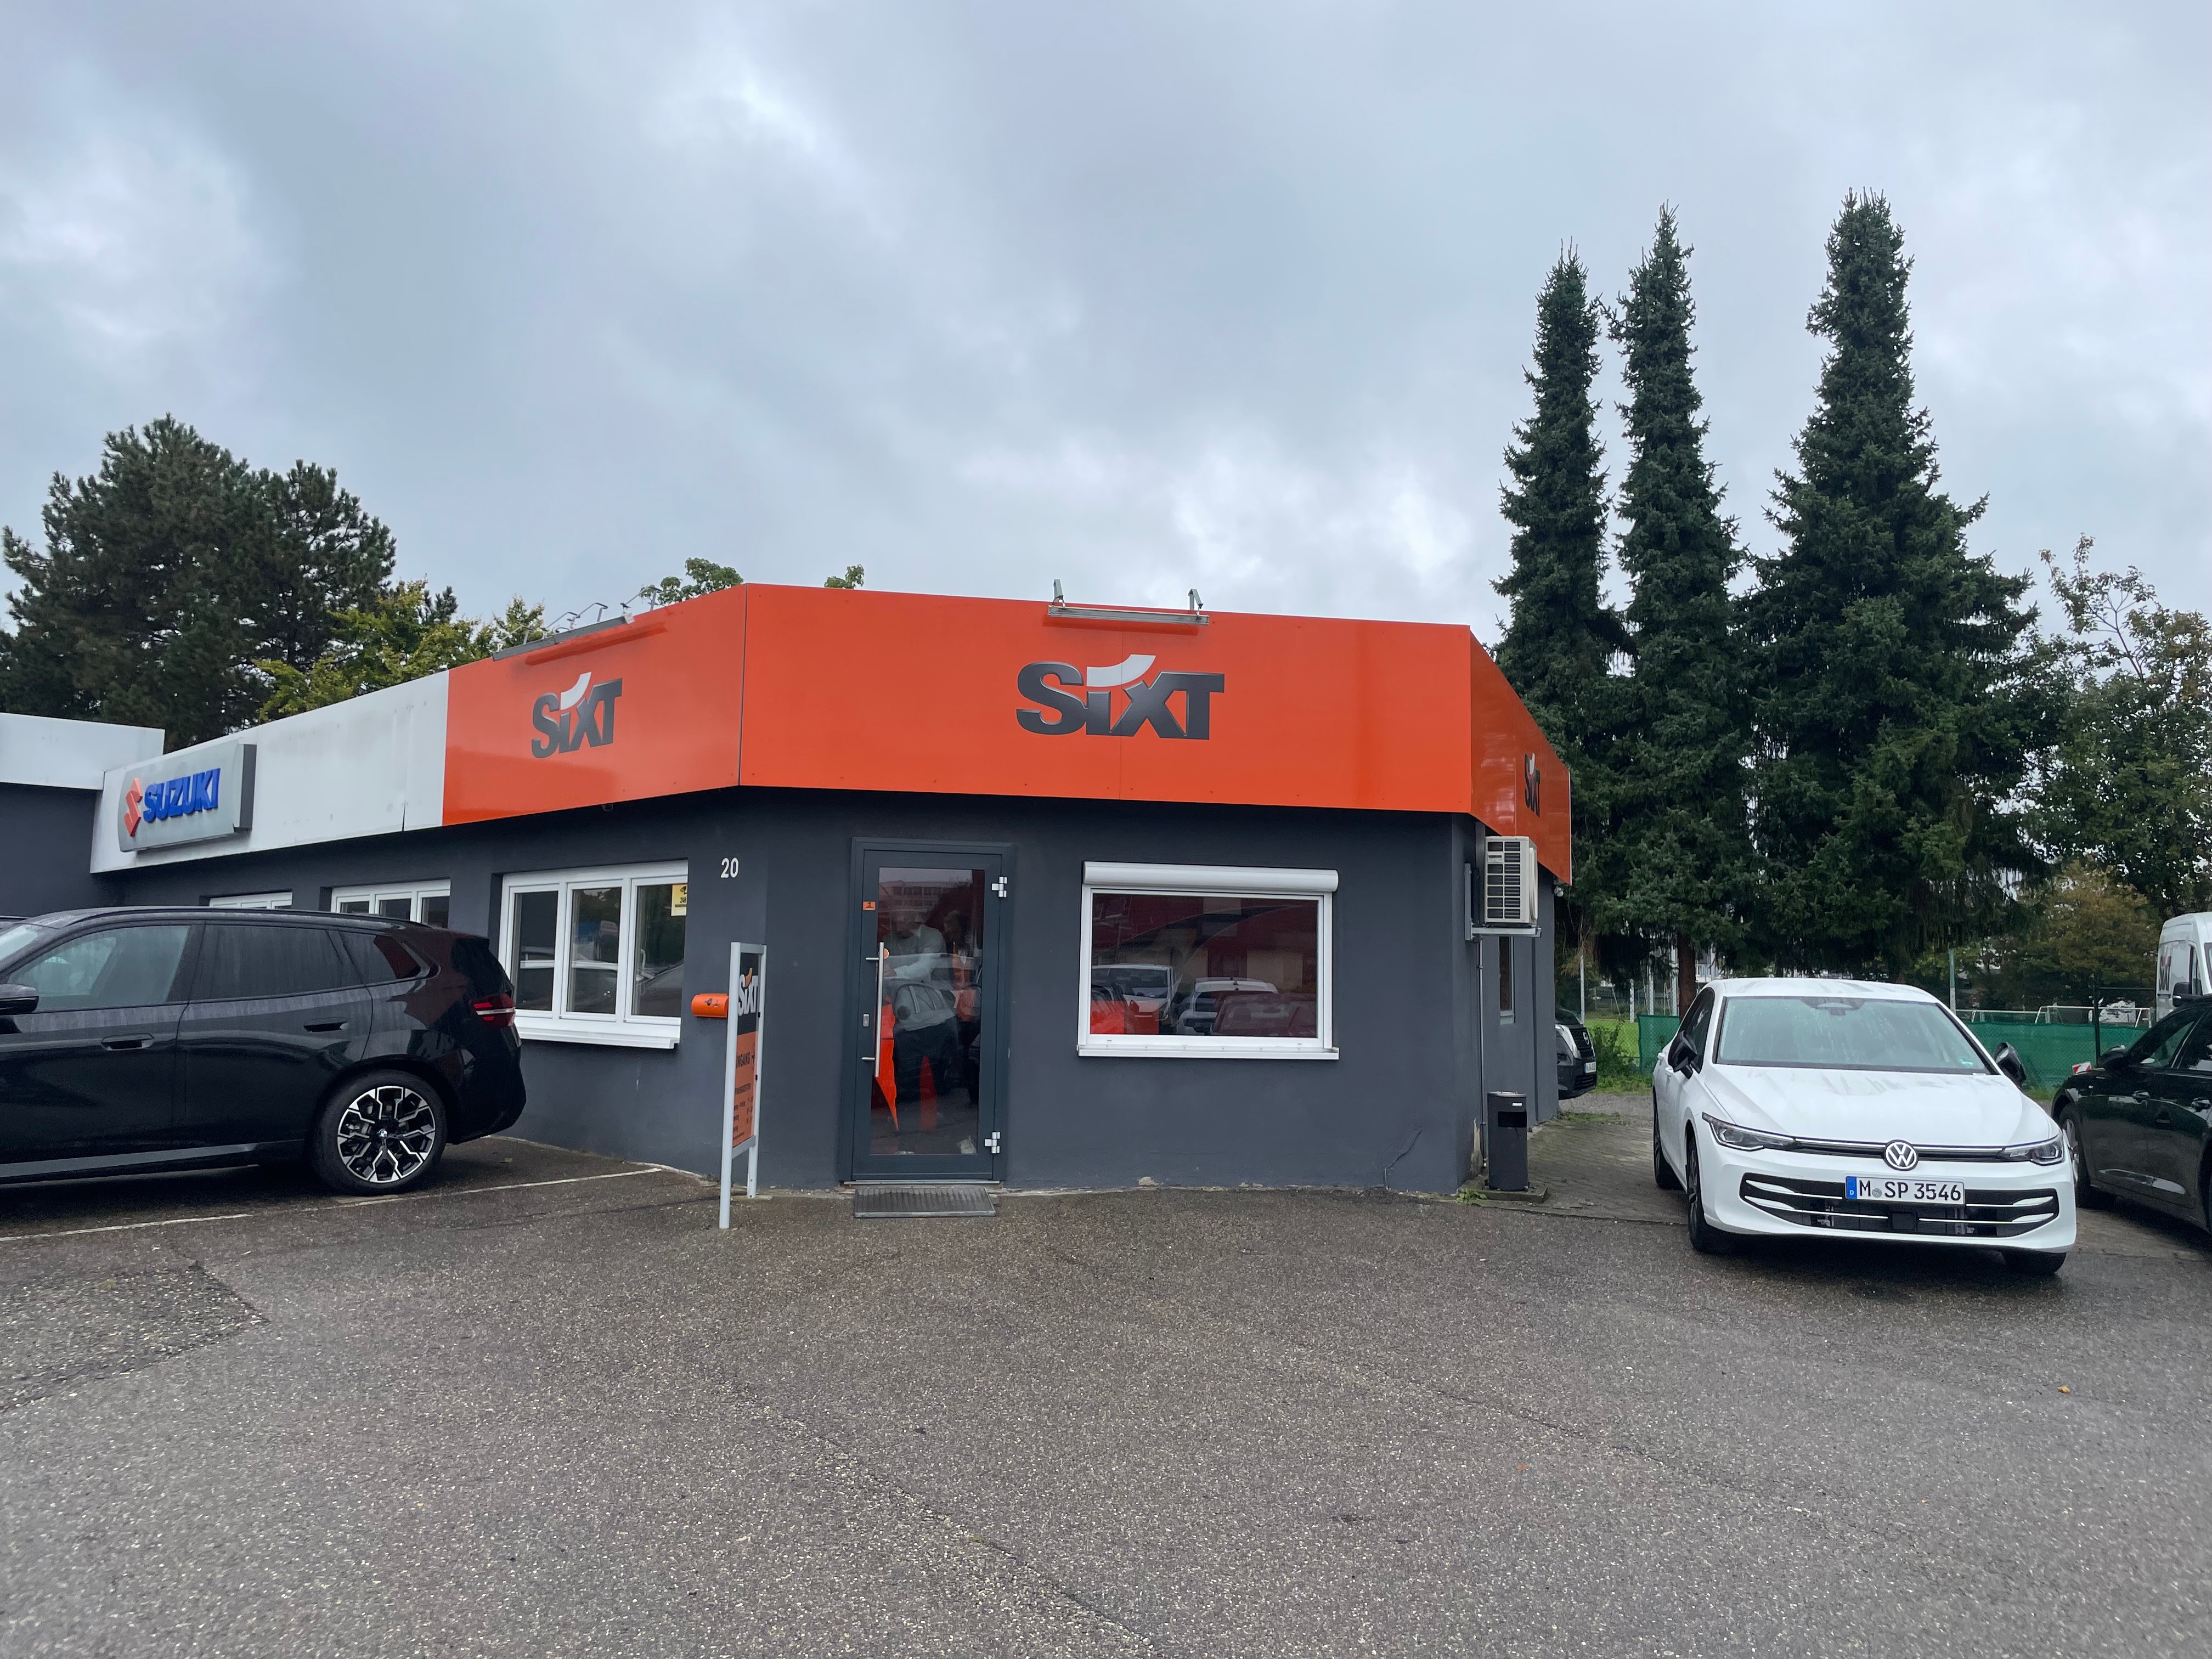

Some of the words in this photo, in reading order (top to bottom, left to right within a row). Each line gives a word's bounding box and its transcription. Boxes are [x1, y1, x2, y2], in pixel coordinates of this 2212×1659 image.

[143, 768, 221, 823] SUZUKI
[720, 857, 739, 878] 20
[1859, 1180, 1871, 1197] M
[1884, 1182, 1909, 1198] SP
[1914, 1183, 1961, 1201] 3546
